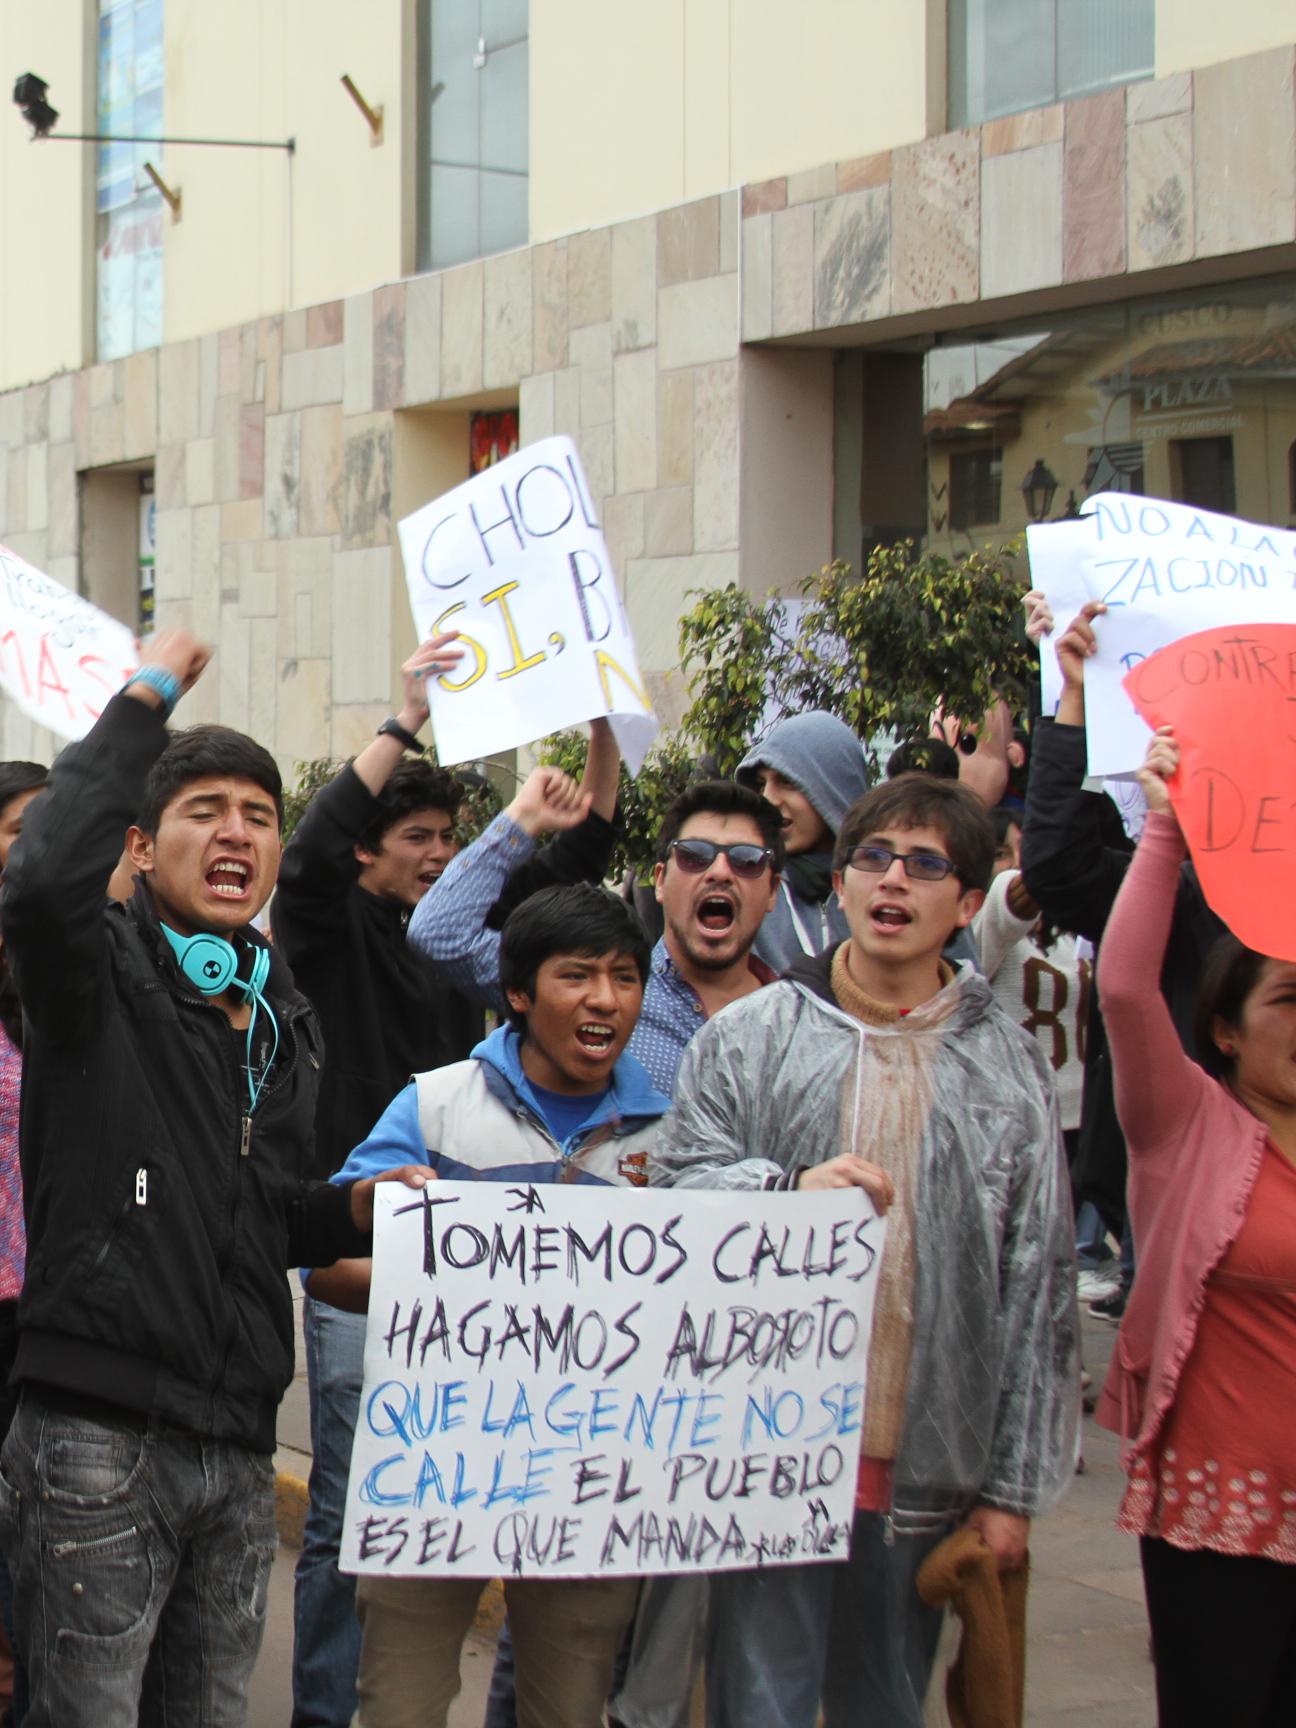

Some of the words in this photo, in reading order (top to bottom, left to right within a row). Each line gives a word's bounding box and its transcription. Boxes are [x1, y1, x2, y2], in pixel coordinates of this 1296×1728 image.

[1144, 377, 1233, 412] PLAZA
[1095, 502, 1171, 541] NO
[1185, 516, 1215, 542] A
[1230, 526, 1280, 557] LA
[1094, 556, 1268, 606] ZACION
[392, 1186, 688, 1285] TOMEMOS
[712, 1215, 876, 1286] CALLES
[383, 1297, 644, 1378] HAGAMOS
[366, 1380, 468, 1448] QUE
[741, 1382, 804, 1451] NO
[805, 1381, 865, 1440] SE
[359, 1448, 564, 1510] CALLE
[571, 1454, 643, 1504] EL
[663, 1443, 845, 1504] PUEBLO
[492, 1511, 583, 1574] QUE
[599, 1510, 748, 1567] MANDA
